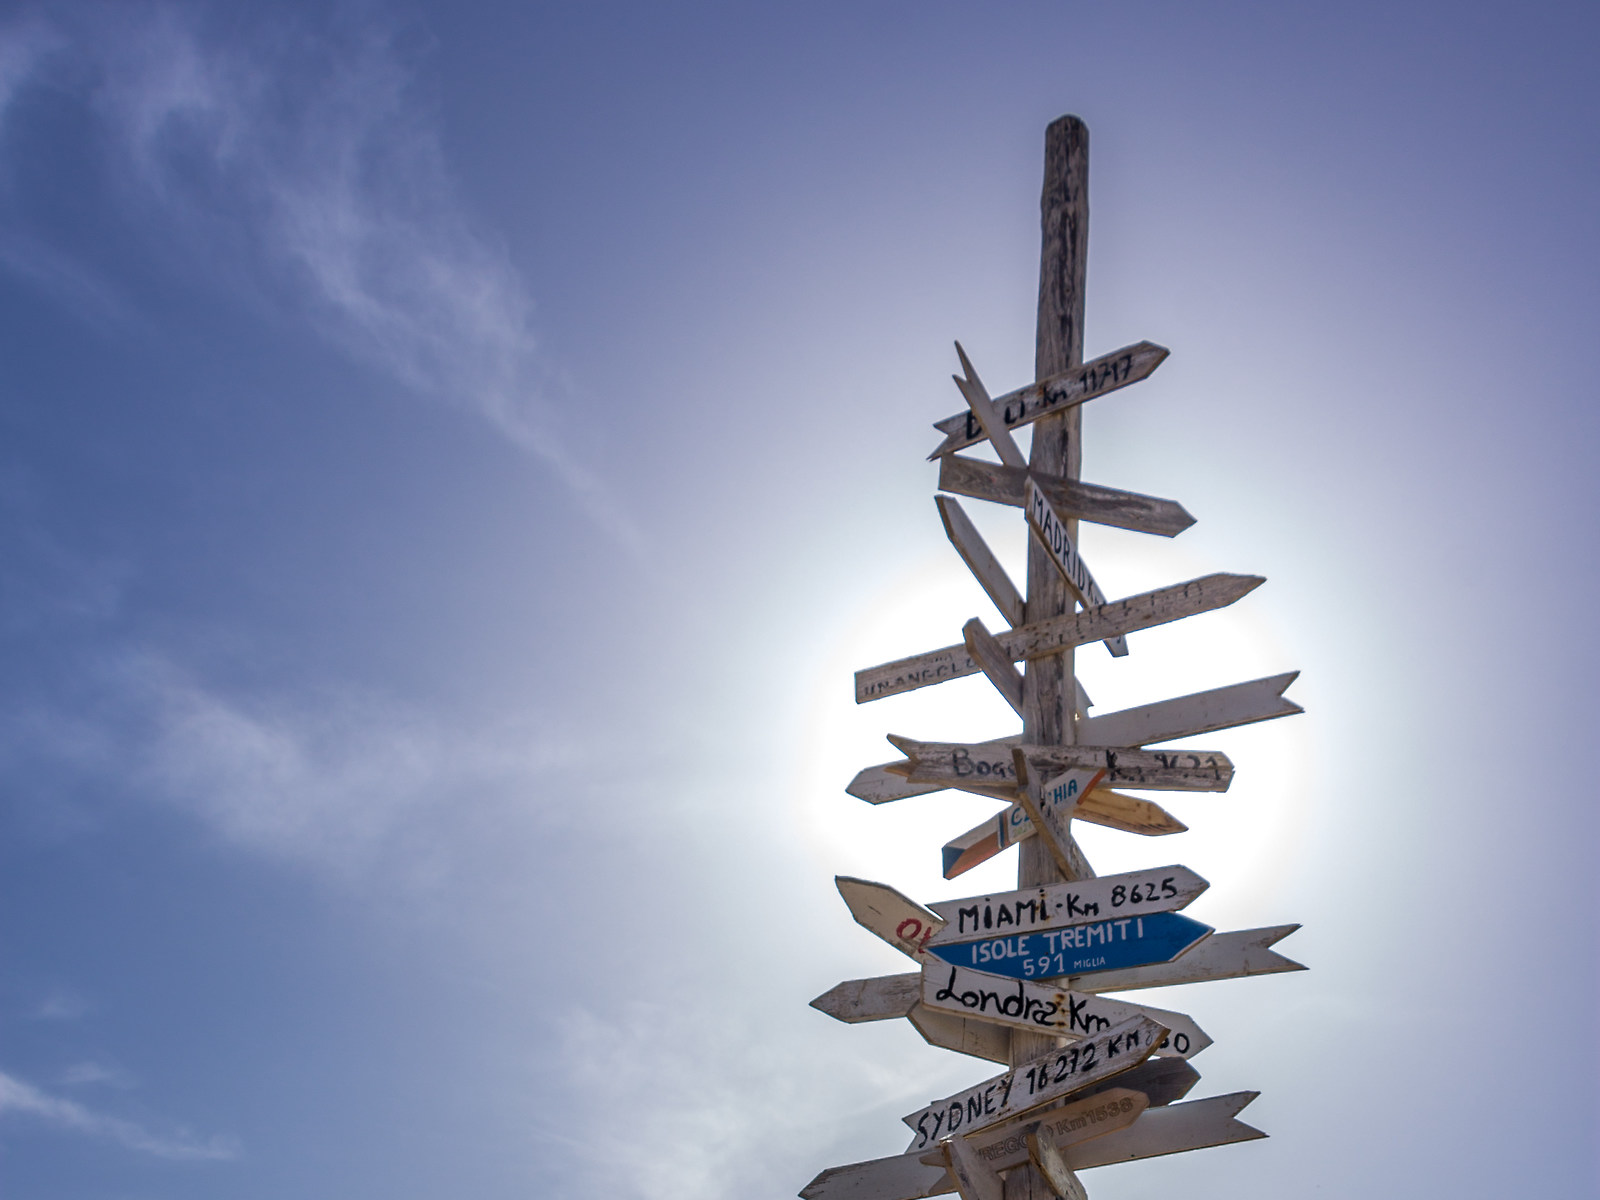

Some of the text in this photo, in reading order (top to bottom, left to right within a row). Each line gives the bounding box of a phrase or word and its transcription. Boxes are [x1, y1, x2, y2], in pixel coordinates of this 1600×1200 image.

[1033, 489, 1084, 591] MADRID
[1111, 877, 1178, 907] 8625
[971, 935, 1030, 965] ISOLE
[1042, 918, 1144, 954] TREMITI
[1022, 953, 1106, 976] 591 MIGLIA
[936, 966, 1058, 1027] Londra
[917, 1073, 1016, 1148] SYDNEY
[1026, 1043, 1099, 1095] 16272
